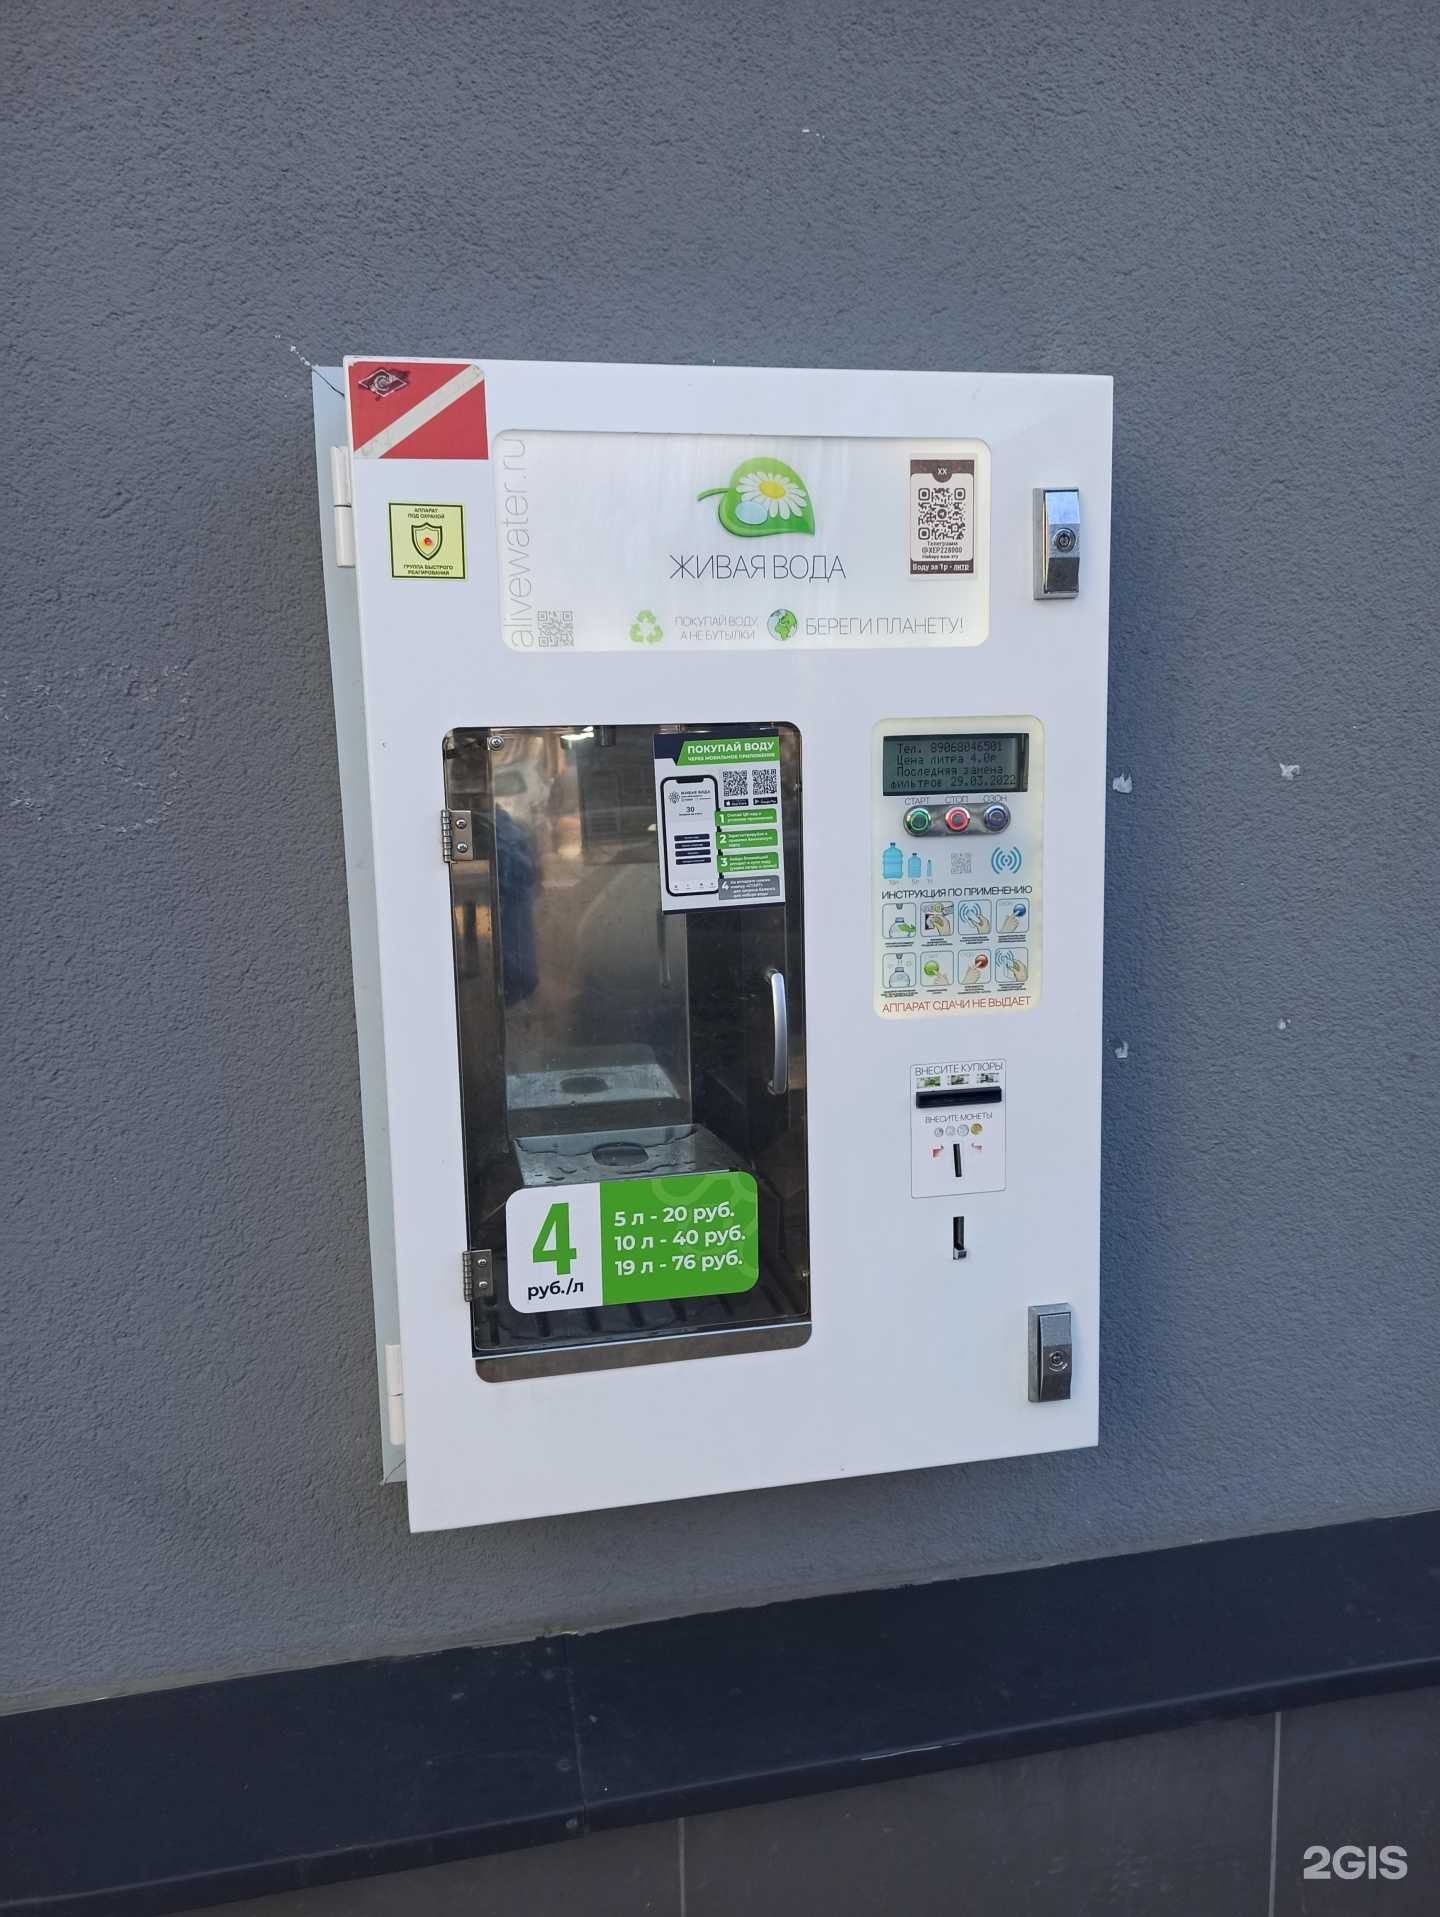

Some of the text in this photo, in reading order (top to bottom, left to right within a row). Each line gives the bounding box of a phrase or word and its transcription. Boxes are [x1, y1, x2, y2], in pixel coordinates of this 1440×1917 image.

[501, 436, 535, 648] alivewater.ru
[669, 554, 846, 583] ЖИВАЯ ВОДА
[912, 563, 930, 571] Воду
[674, 615, 728, 627] ПОКУПАЙ
[805, 616, 965, 635] БЕРЕГИ ПЛАНЕТУ!
[680, 630, 756, 640] А НЕ БУТЫЛКИ
[687, 741, 774, 754] ПОКУПАЙ ВОДУ
[896, 755, 924, 766] Цена
[930, 755, 964, 765] литра
[896, 765, 1004, 778] Последняя замена
[951, 774, 1016, 787] 29.03.2022
[904, 797, 930, 805] СТАРТ
[944, 795, 969, 804] СТОП
[983, 794, 1008, 803] ОЗОН
[719, 814, 725, 823] 1
[719, 834, 728, 844] 2
[720, 857, 729, 867] 3
[721, 881, 730, 890] 4
[881, 885, 1033, 900] ИНСТРУКЦИЯ ПО ПРИМЕНЕНИЮ
[882, 995, 1032, 1013] АППАРАТ СДАЧИ НЕ ВЫДАЕТ
[914, 1061, 1003, 1077] ВНЕСИТЕ КУПЮРЫ
[924, 1111, 993, 1124] ВНЕСИТЕ МОНЕТЫ
[614, 1211, 626, 1227] 5
[631, 1212, 644, 1225] л
[662, 1206, 688, 1223] 20
[693, 1201, 735, 1224] руб.
[532, 1202, 577, 1275] 4
[614, 1235, 635, 1251] 10
[641, 1236, 654, 1249] л
[672, 1229, 699, 1246] 40
[704, 1225, 746, 1247] руб.
[614, 1260, 635, 1276] 19
[641, 1260, 654, 1274] л
[671, 1254, 697, 1271] 76
[701, 1250, 743, 1272] руб.
[527, 1278, 584, 1300] руб./л
